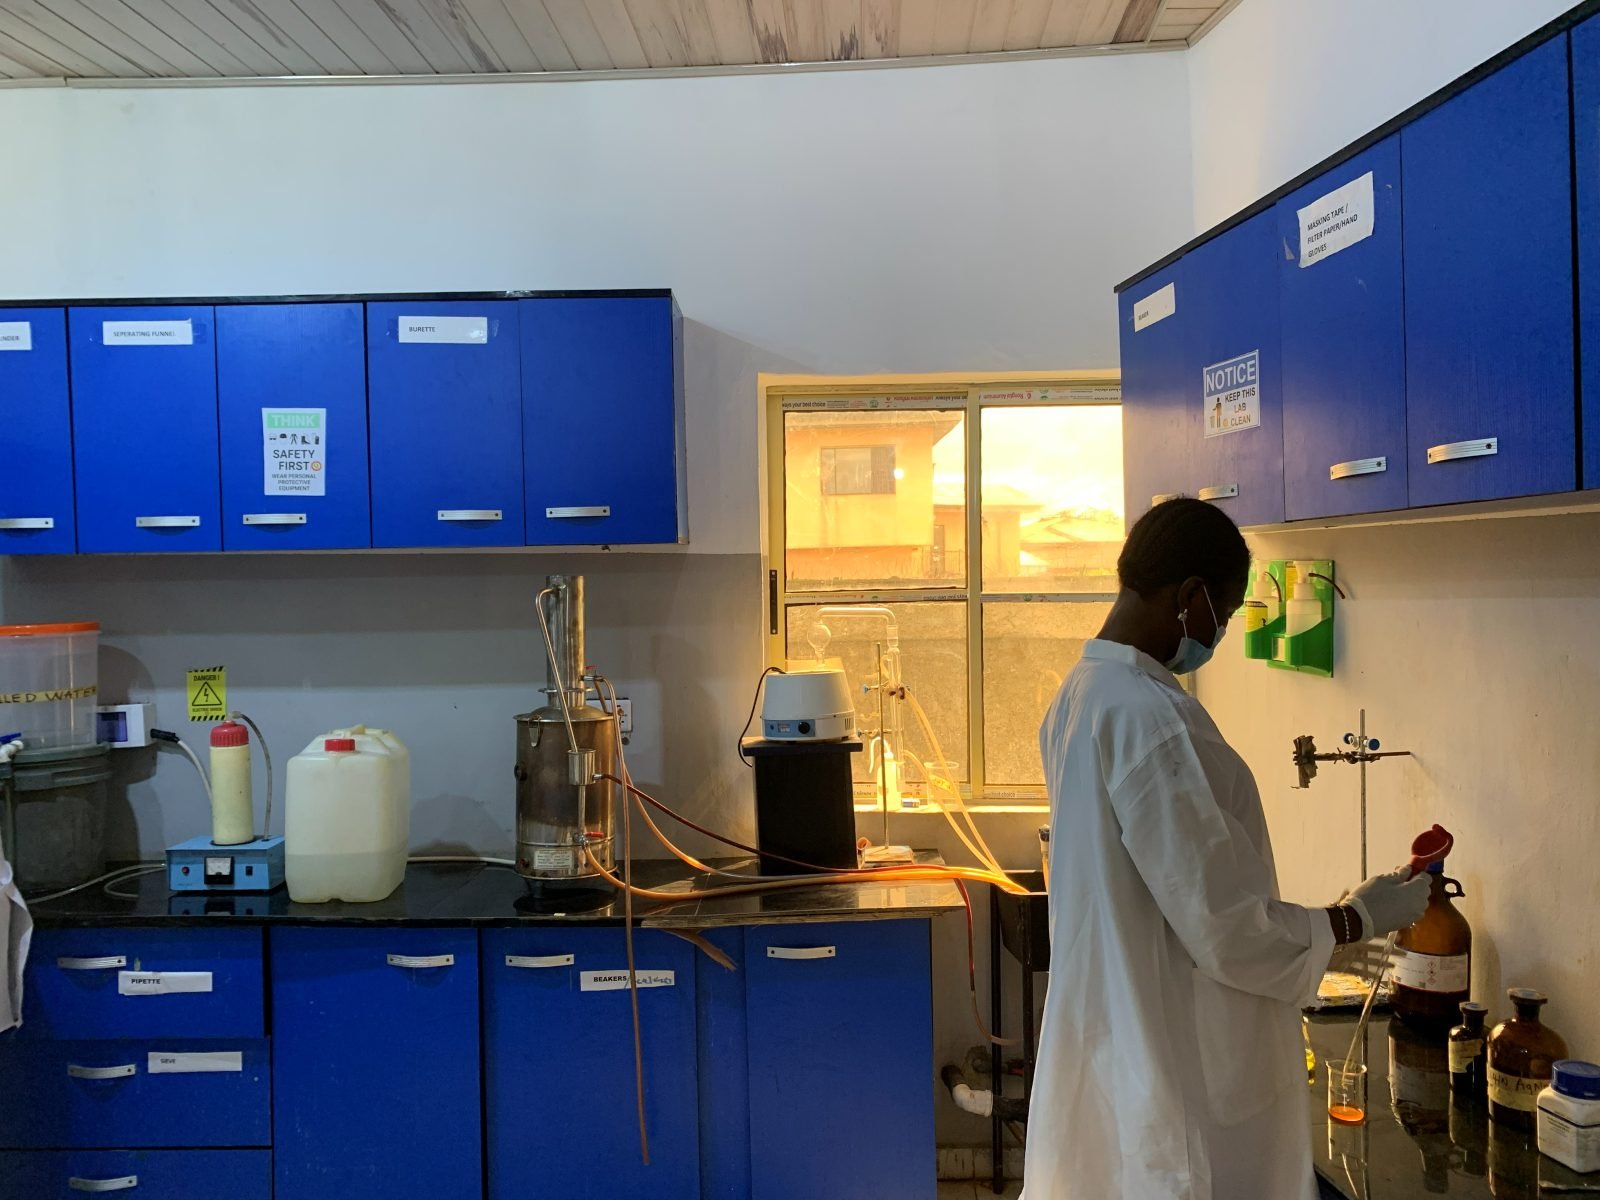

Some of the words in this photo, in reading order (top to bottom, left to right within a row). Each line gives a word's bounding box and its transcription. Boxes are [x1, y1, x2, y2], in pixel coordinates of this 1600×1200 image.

[1307, 213, 1330, 231] MASKING
[1331, 205, 1345, 218] TAPE
[1307, 231, 1323, 244] FILTER
[1308, 242, 1327, 258] GLOVES
[1206, 360, 1256, 393] NOTICE
[1225, 391, 1241, 403] KEEP
[1242, 387, 1256, 399] THIS
[1234, 402, 1247, 413] LAB
[271, 414, 316, 427] THINK
[1230, 415, 1251, 426] CLEAN
[272, 449, 315, 459] SAFETY
[278, 461, 310, 471] FIRST
[593, 975, 627, 983] BEAKERS
